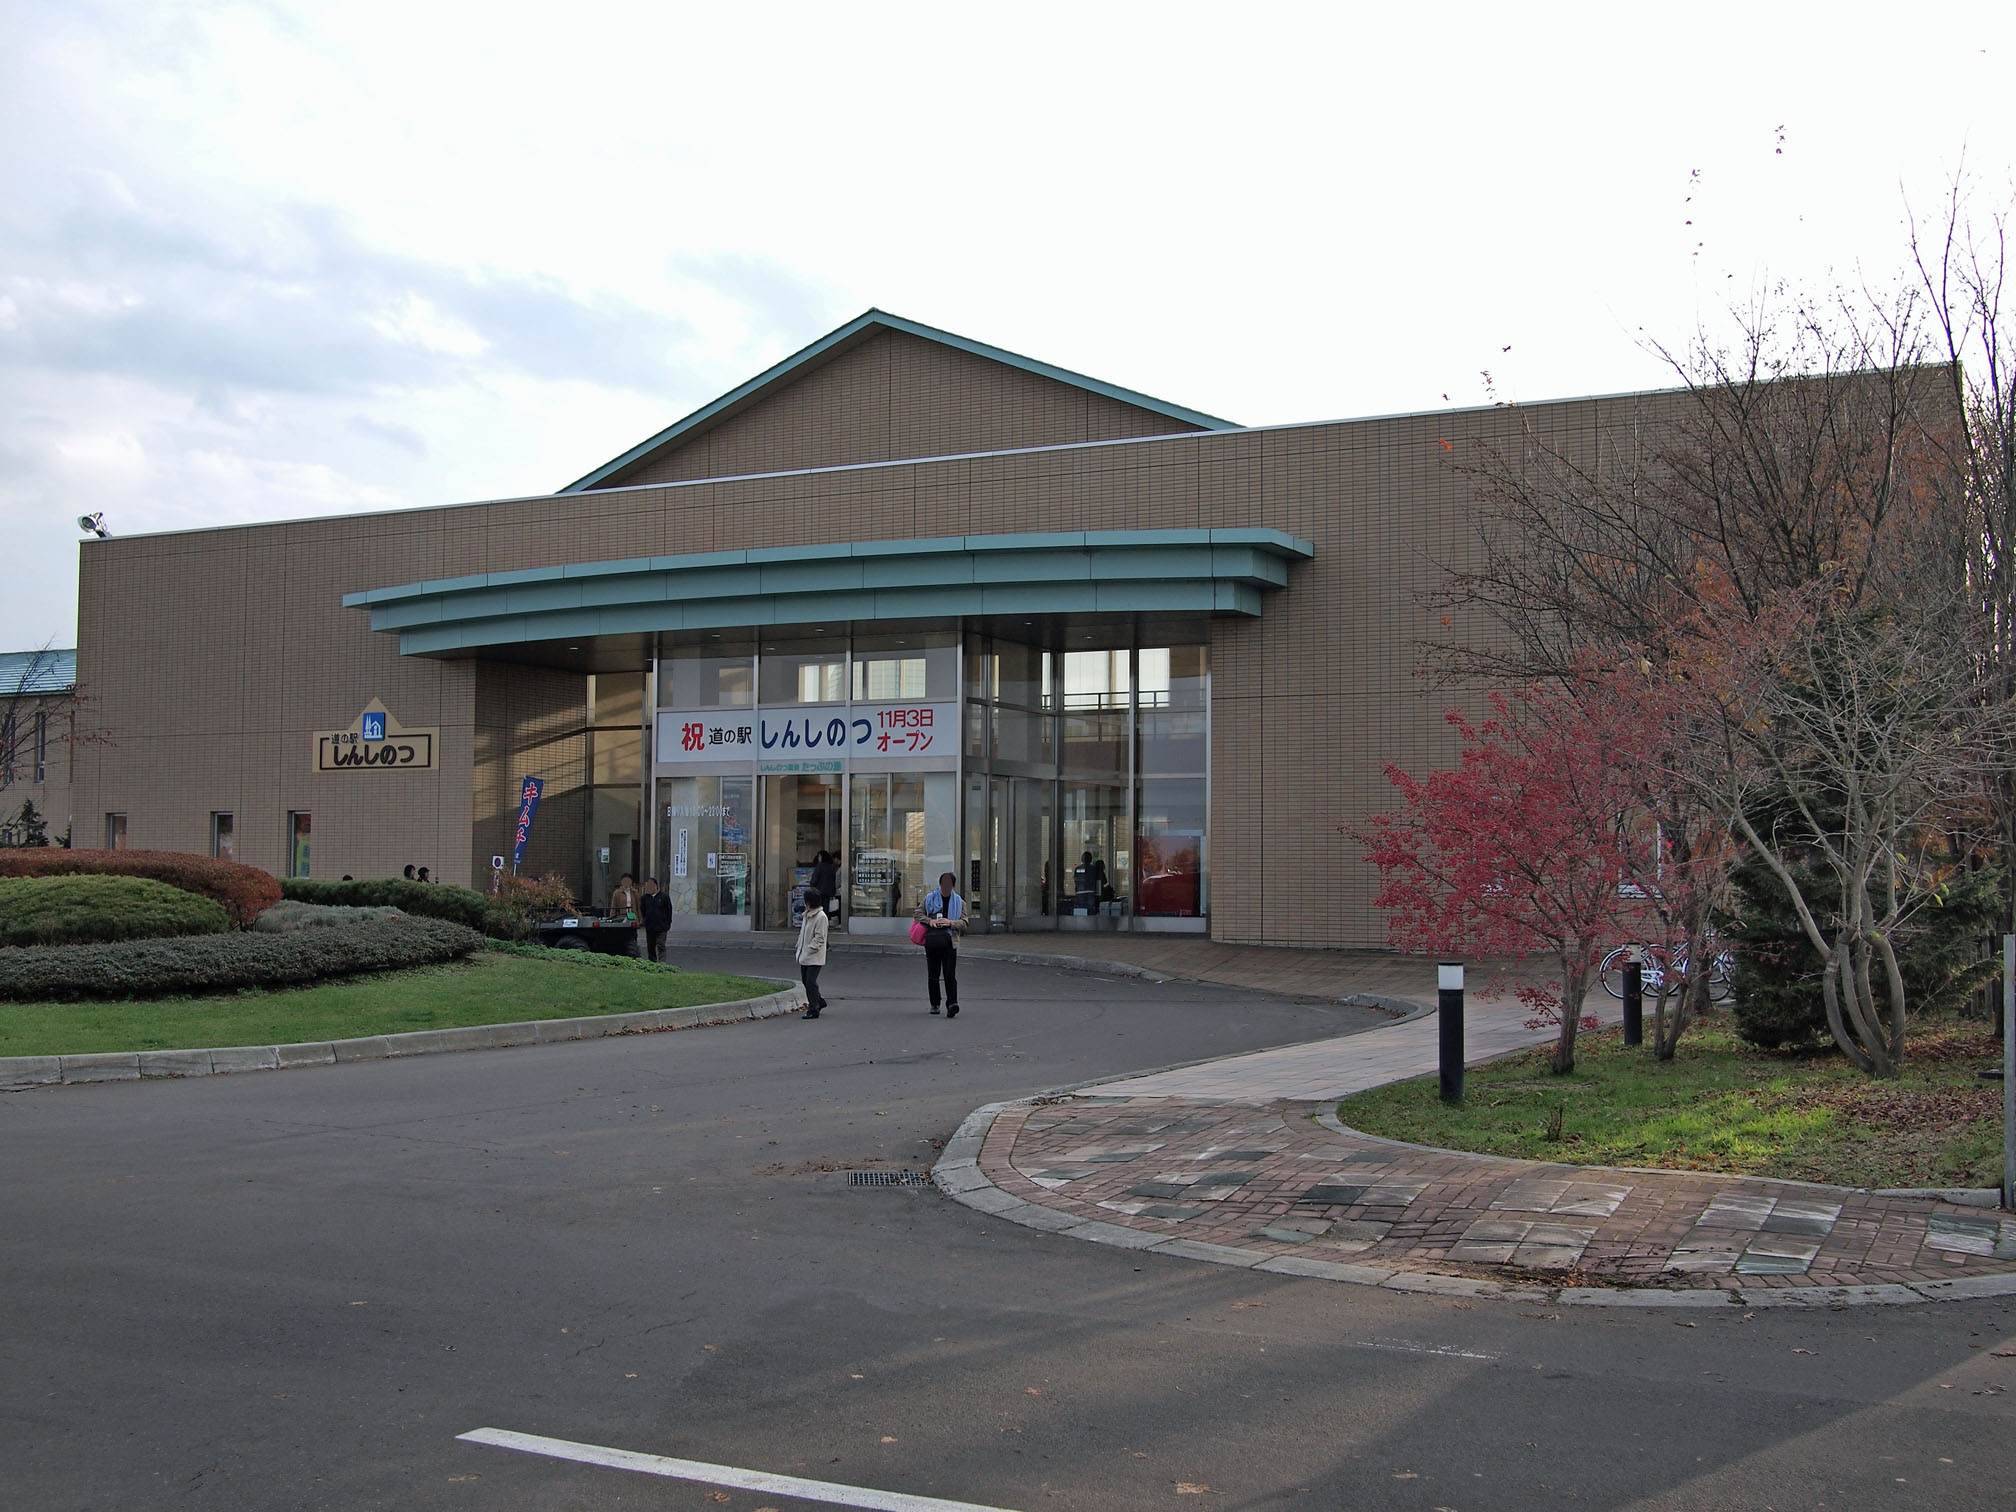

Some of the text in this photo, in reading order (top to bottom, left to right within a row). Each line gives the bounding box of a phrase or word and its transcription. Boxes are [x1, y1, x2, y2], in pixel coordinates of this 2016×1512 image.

[877, 709, 934, 728] 11月3日
[331, 733, 358, 744] 道の駅
[681, 718, 872, 751] 祝 道の駅 しんしのつ
[877, 730, 933, 752] オープン
[333, 744, 415, 766] しんしのつ
[513, 782, 538, 849] キムチ
